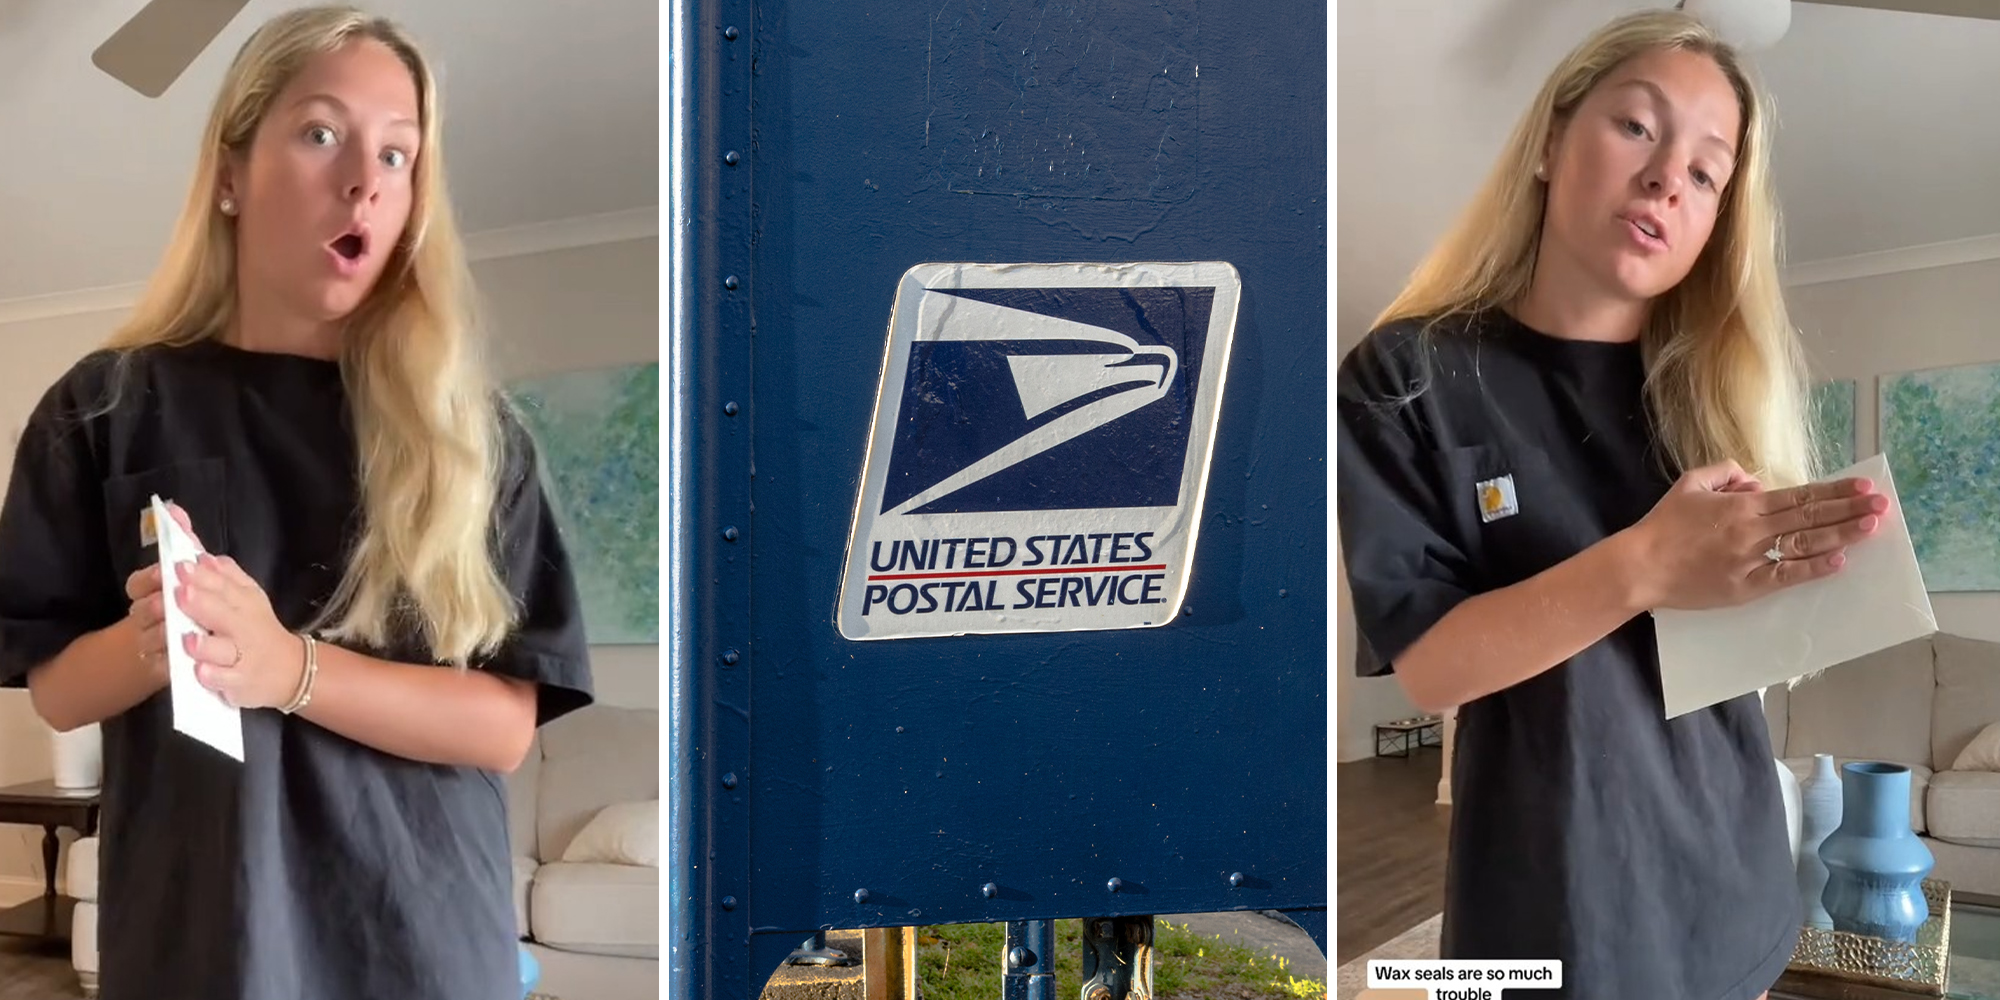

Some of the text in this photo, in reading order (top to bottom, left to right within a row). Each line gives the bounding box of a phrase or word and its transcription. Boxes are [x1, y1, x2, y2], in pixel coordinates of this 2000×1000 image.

[870, 531, 1154, 571] UNITED STATES
[862, 580, 1004, 616] POSTAL
